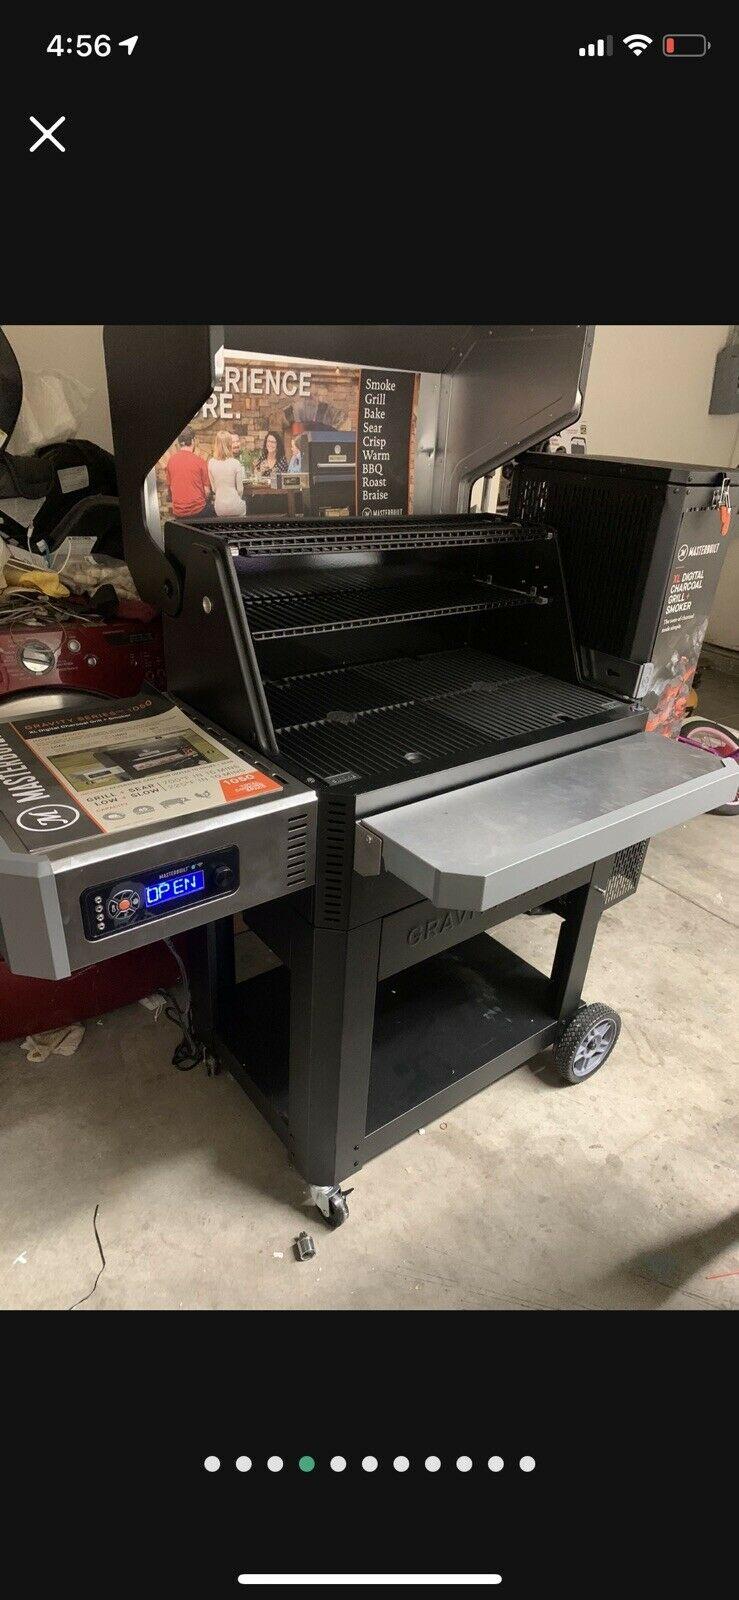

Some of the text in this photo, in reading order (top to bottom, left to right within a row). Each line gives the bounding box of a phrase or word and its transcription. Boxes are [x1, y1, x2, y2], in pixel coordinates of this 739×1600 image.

[365, 378, 396, 392] Smoke
[364, 393, 386, 406] Grill
[364, 407, 386, 420] Bake
[363, 421, 382, 433] Sear
[362, 435, 387, 449] Crisp
[362, 449, 390, 461] Warm
[362, 463, 383, 476] BBQ
[362, 476, 387, 488] Roast
[362, 490, 388, 501] Braise
[689, 543, 720, 556] MASTERBUILT
[673, 570, 704, 583] XL DIGITAL
[670, 580, 702, 593] CHARCOAL
[668, 593, 685, 604] GRILL
[665, 601, 692, 615] SMOKER
[222, 773, 255, 785] 1050
[86, 792, 115, 803] GRILL
[128, 783, 155, 793] SEAR
[94, 797, 118, 807] LOW
[130, 788, 161, 798] SLOW
[146, 875, 197, 905] OPEN
